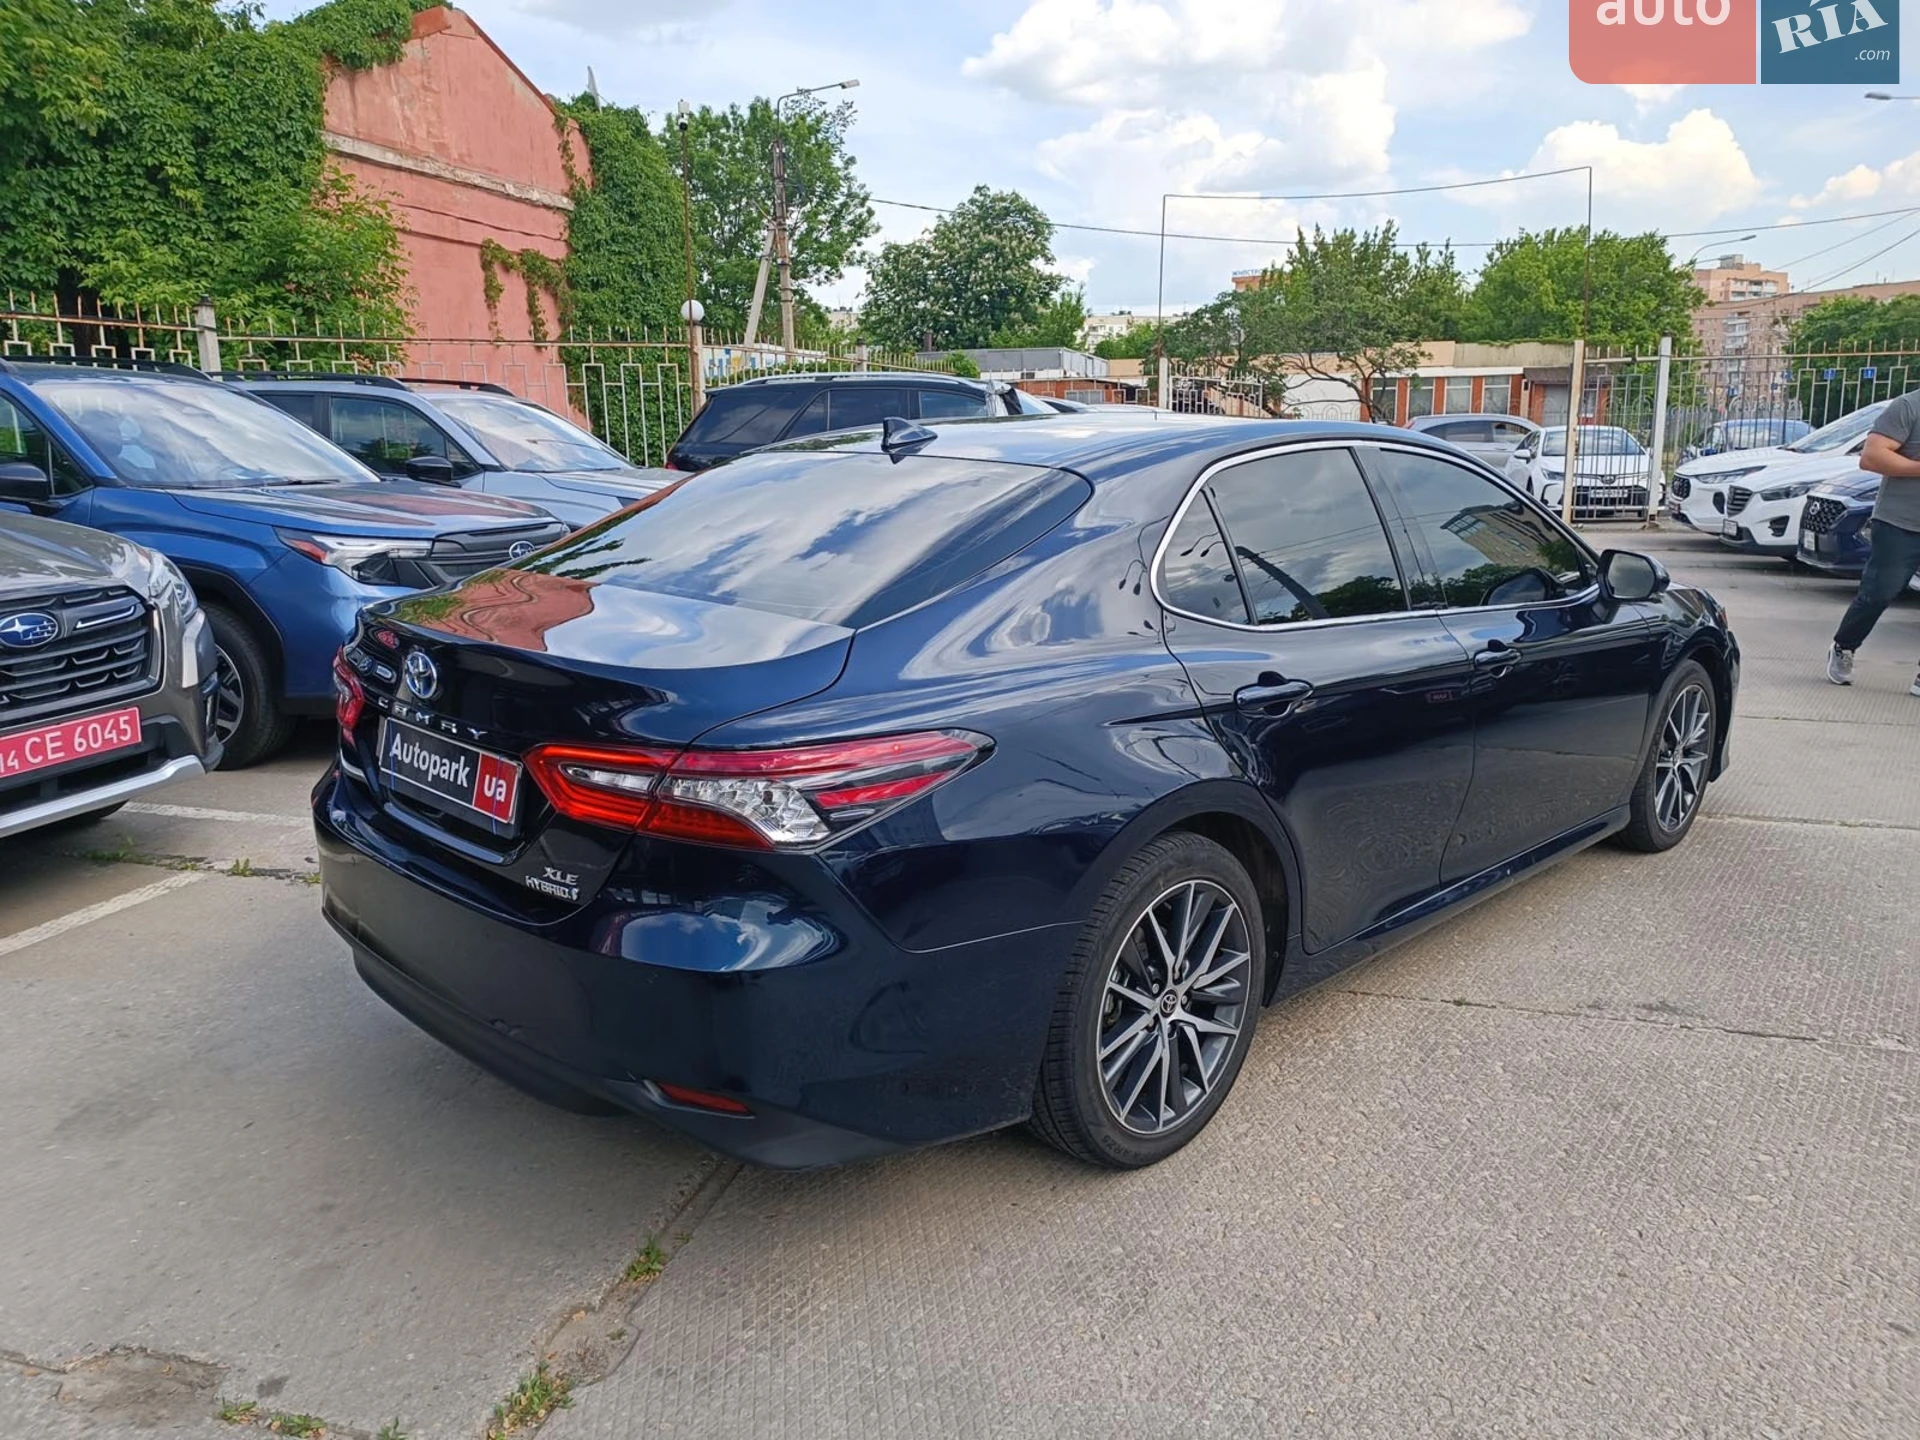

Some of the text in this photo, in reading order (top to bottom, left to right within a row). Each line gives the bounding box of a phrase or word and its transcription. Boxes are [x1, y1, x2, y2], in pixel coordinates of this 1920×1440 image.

[24, 731, 65, 764] CE
[73, 715, 131, 752] 6045
[389, 732, 507, 803] Autopark ua
[542, 866, 579, 886] XLE
